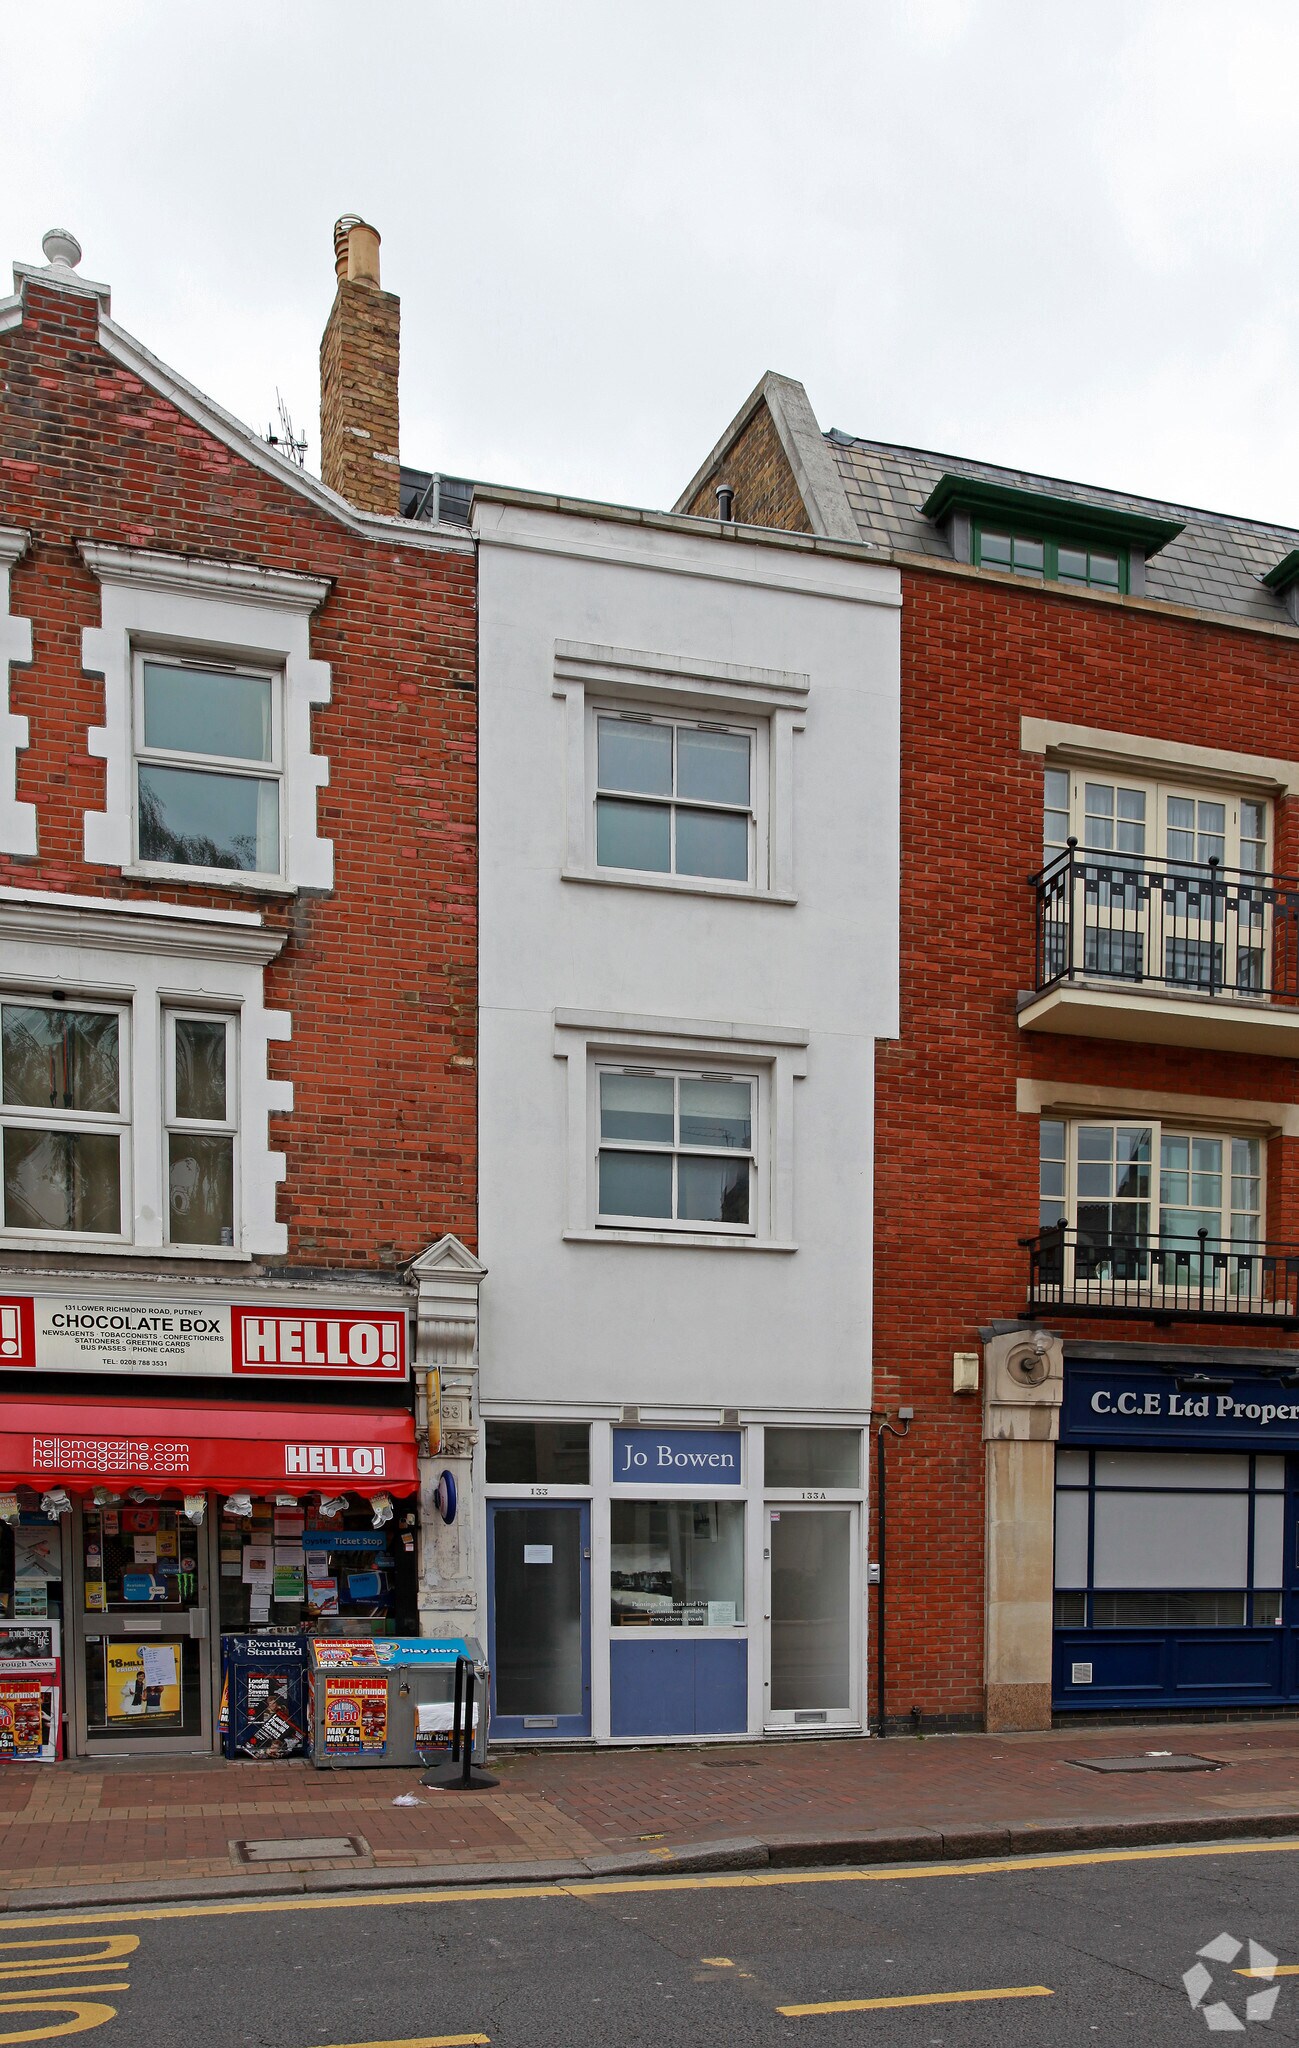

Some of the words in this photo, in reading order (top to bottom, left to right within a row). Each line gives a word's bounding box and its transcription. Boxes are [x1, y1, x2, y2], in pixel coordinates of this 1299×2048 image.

[106, 1306, 147, 1314] RICHMOND
[149, 1308, 172, 1316] ROAD,
[51, 1313, 174, 1332] CHOCOLATE
[180, 1319, 221, 1333] BOX
[42, 1330, 95, 1338] NEWSAGENTS
[100, 1331, 158, 1340] TOBACCONISTS
[163, 1334, 225, 1342] CONFECTIONERS
[126, 1339, 164, 1347] GREETING
[165, 1340, 191, 1348] CARDS
[246, 1319, 396, 1367] HELLO!
[1090, 1391, 1162, 1416] C.C.E
[1168, 1394, 1210, 1417] Ltd
[33, 1437, 189, 1452] hellomagazine.com
[33, 1447, 189, 1462] hellomagazine.com
[288, 1446, 383, 1475] HELLO!
[622, 1444, 648, 1471] Jo
[656, 1445, 735, 1468] Bowen
[33, 1457, 189, 1472] hellomagazine.com
[530, 1488, 548, 1496] 133
[801, 1492, 827, 1500] 133A
[362, 1538, 383, 1546] Stop
[9, 1628, 50, 1640] intelligent
[248, 1640, 296, 1649] Evening
[109, 1658, 123, 1668] 18
[328, 1711, 359, 1721] £1.50
